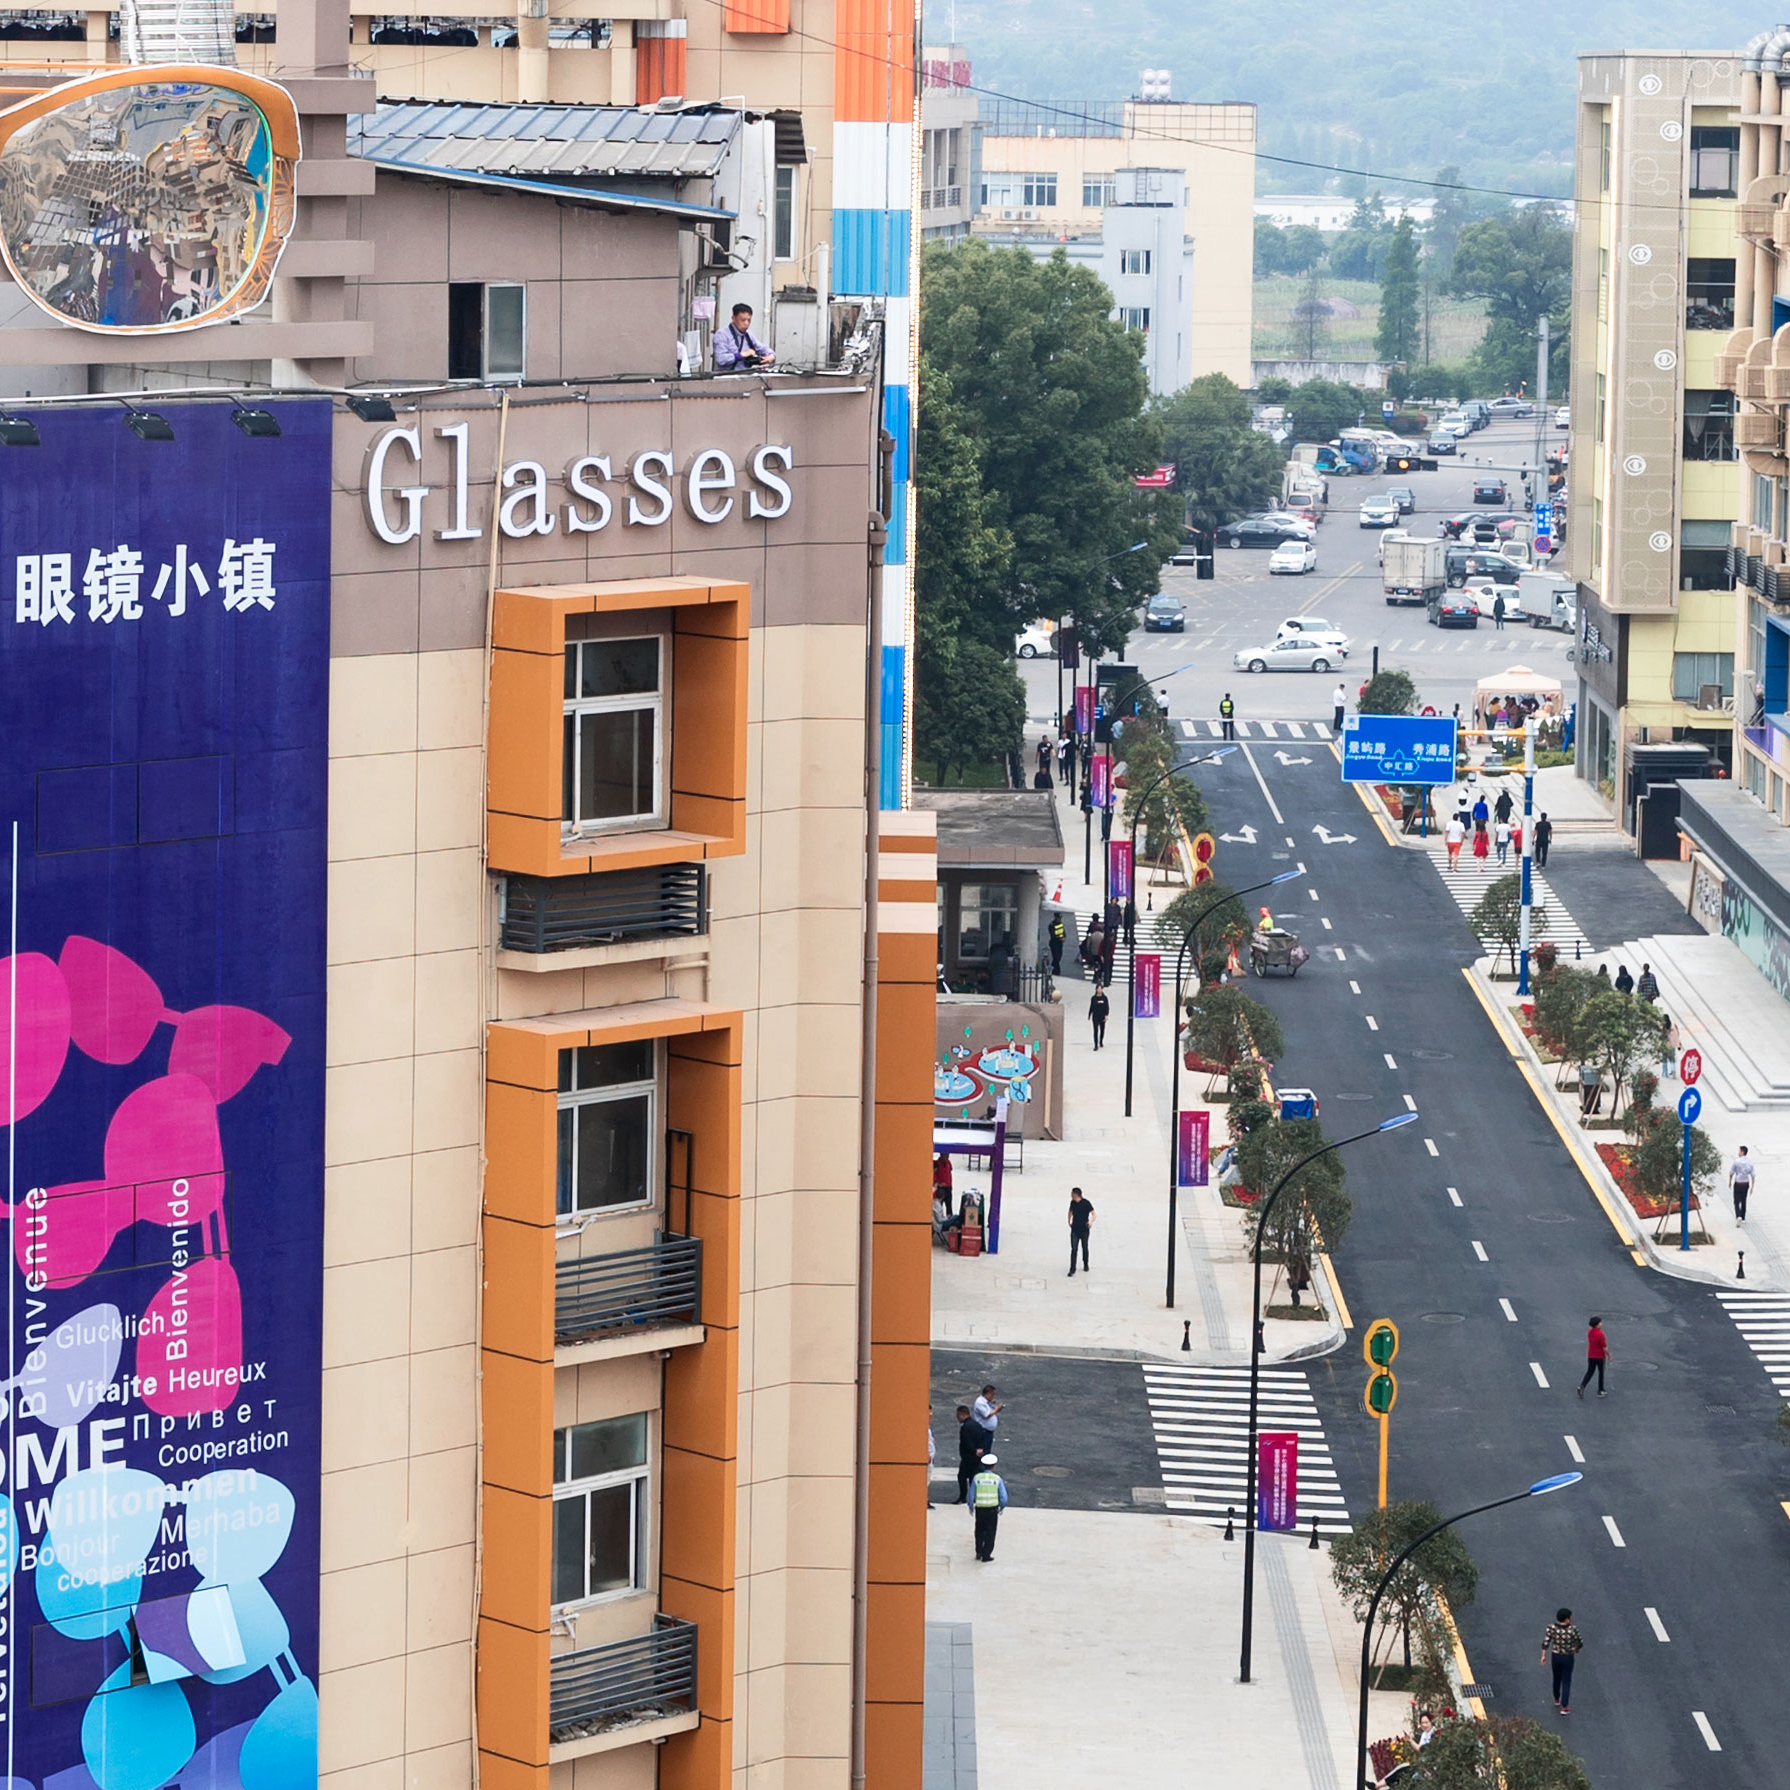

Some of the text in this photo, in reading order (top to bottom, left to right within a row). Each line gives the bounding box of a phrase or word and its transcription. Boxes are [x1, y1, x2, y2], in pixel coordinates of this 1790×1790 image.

[365, 422, 794, 544] Glasses
[1684, 1055, 1699, 1080] 停
[166, 1178, 190, 1361] Bienvenido
[19, 1187, 47, 1418] Bienvenue
[56, 1311, 165, 1348] Glucklich
[66, 1361, 267, 1407] Vitajte Heureux
[158, 1429, 289, 1467] Cooperation
[24, 1467, 258, 1535] Willkommen
[161, 1502, 281, 1546] Merhaba
[20, 1532, 121, 1571] Bonjour
[57, 1545, 209, 1592] cooperazione
